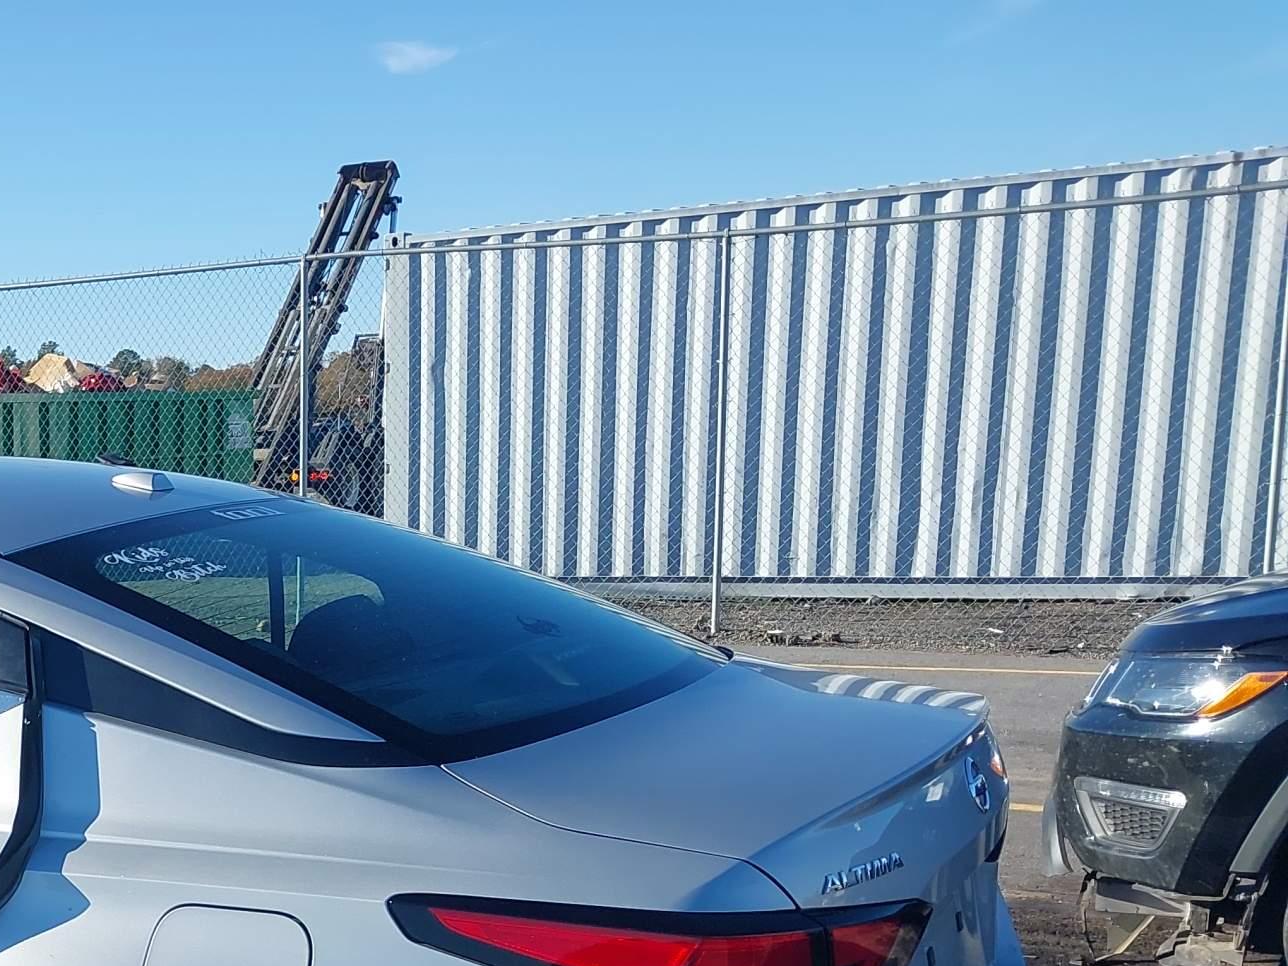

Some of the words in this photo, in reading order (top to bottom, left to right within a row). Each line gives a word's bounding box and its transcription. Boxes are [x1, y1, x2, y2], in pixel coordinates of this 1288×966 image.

[104, 547, 169, 565] Kids
[165, 561, 227, 583] Bitch
[822, 852, 904, 895] ALTIMA
